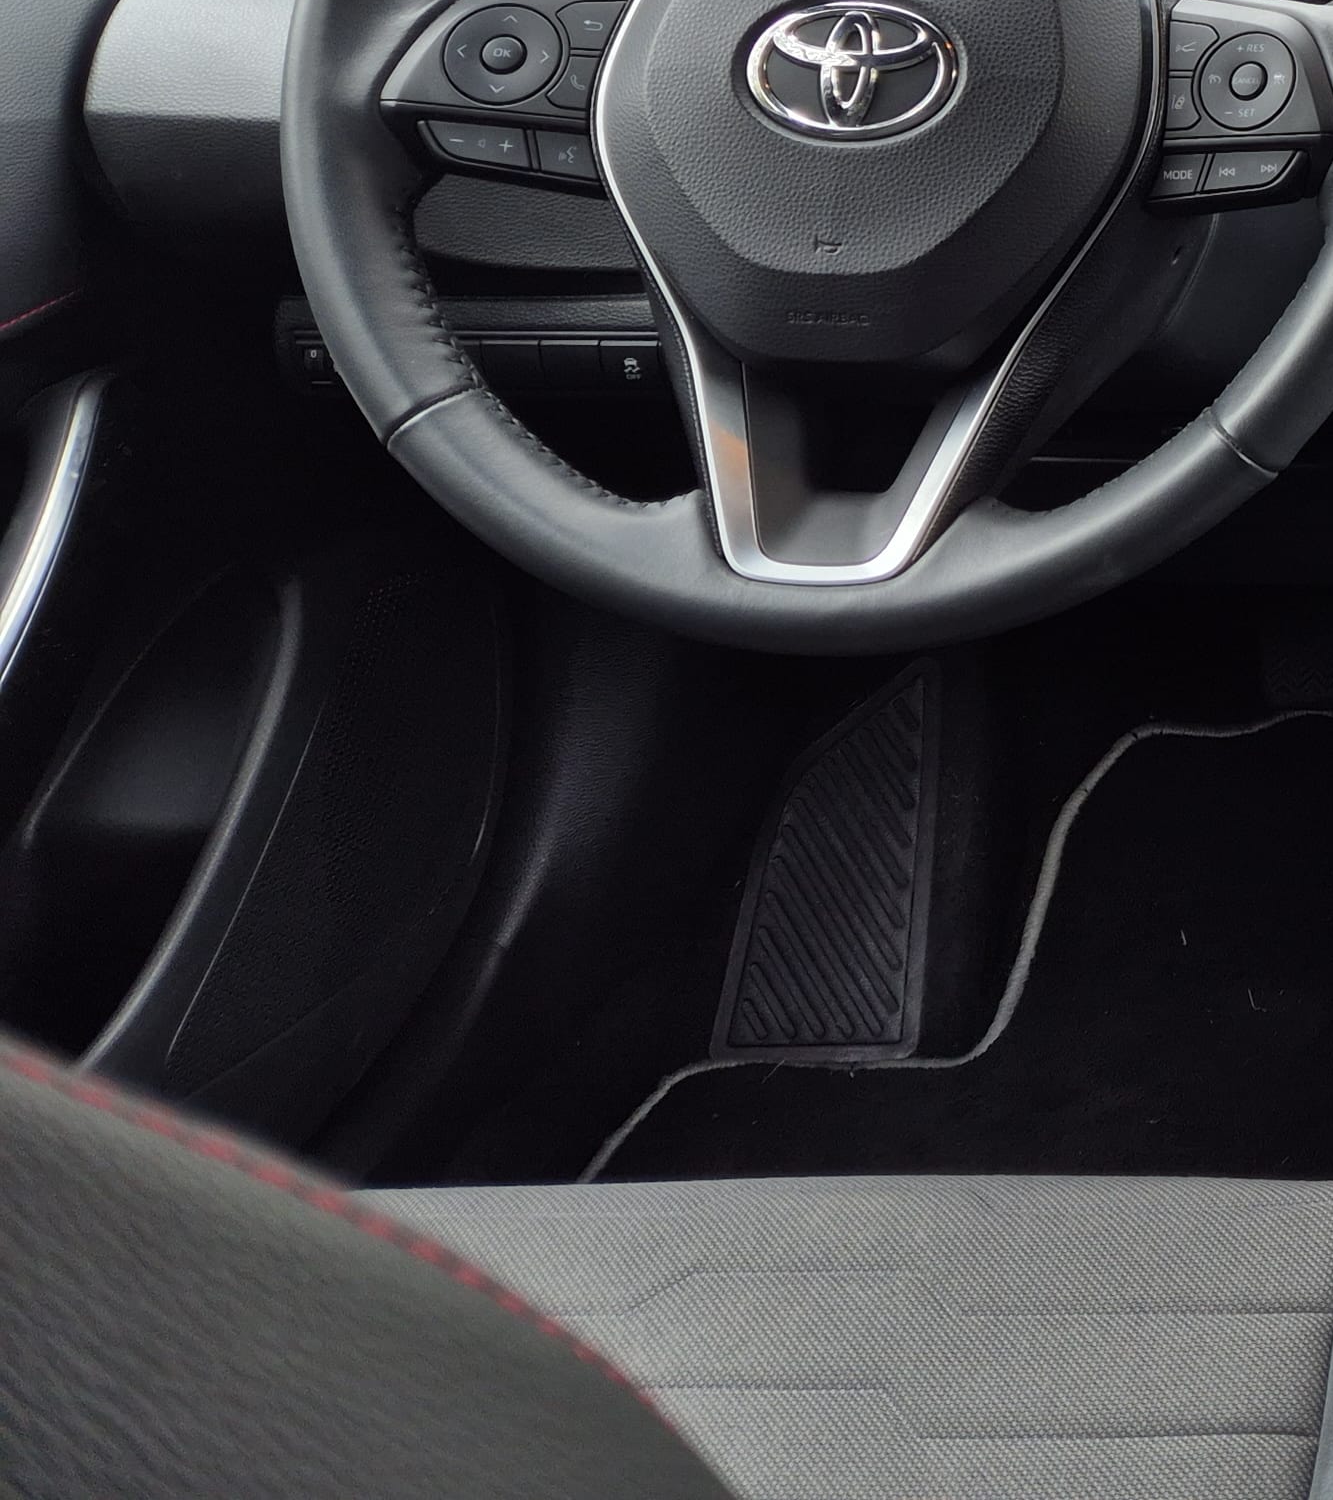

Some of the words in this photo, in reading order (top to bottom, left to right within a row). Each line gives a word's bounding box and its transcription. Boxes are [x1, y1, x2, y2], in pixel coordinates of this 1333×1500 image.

[493, 47, 512, 58] OK
[1246, 43, 1265, 53] RES
[1237, 108, 1256, 118] SET
[1163, 169, 1193, 180] MODE
